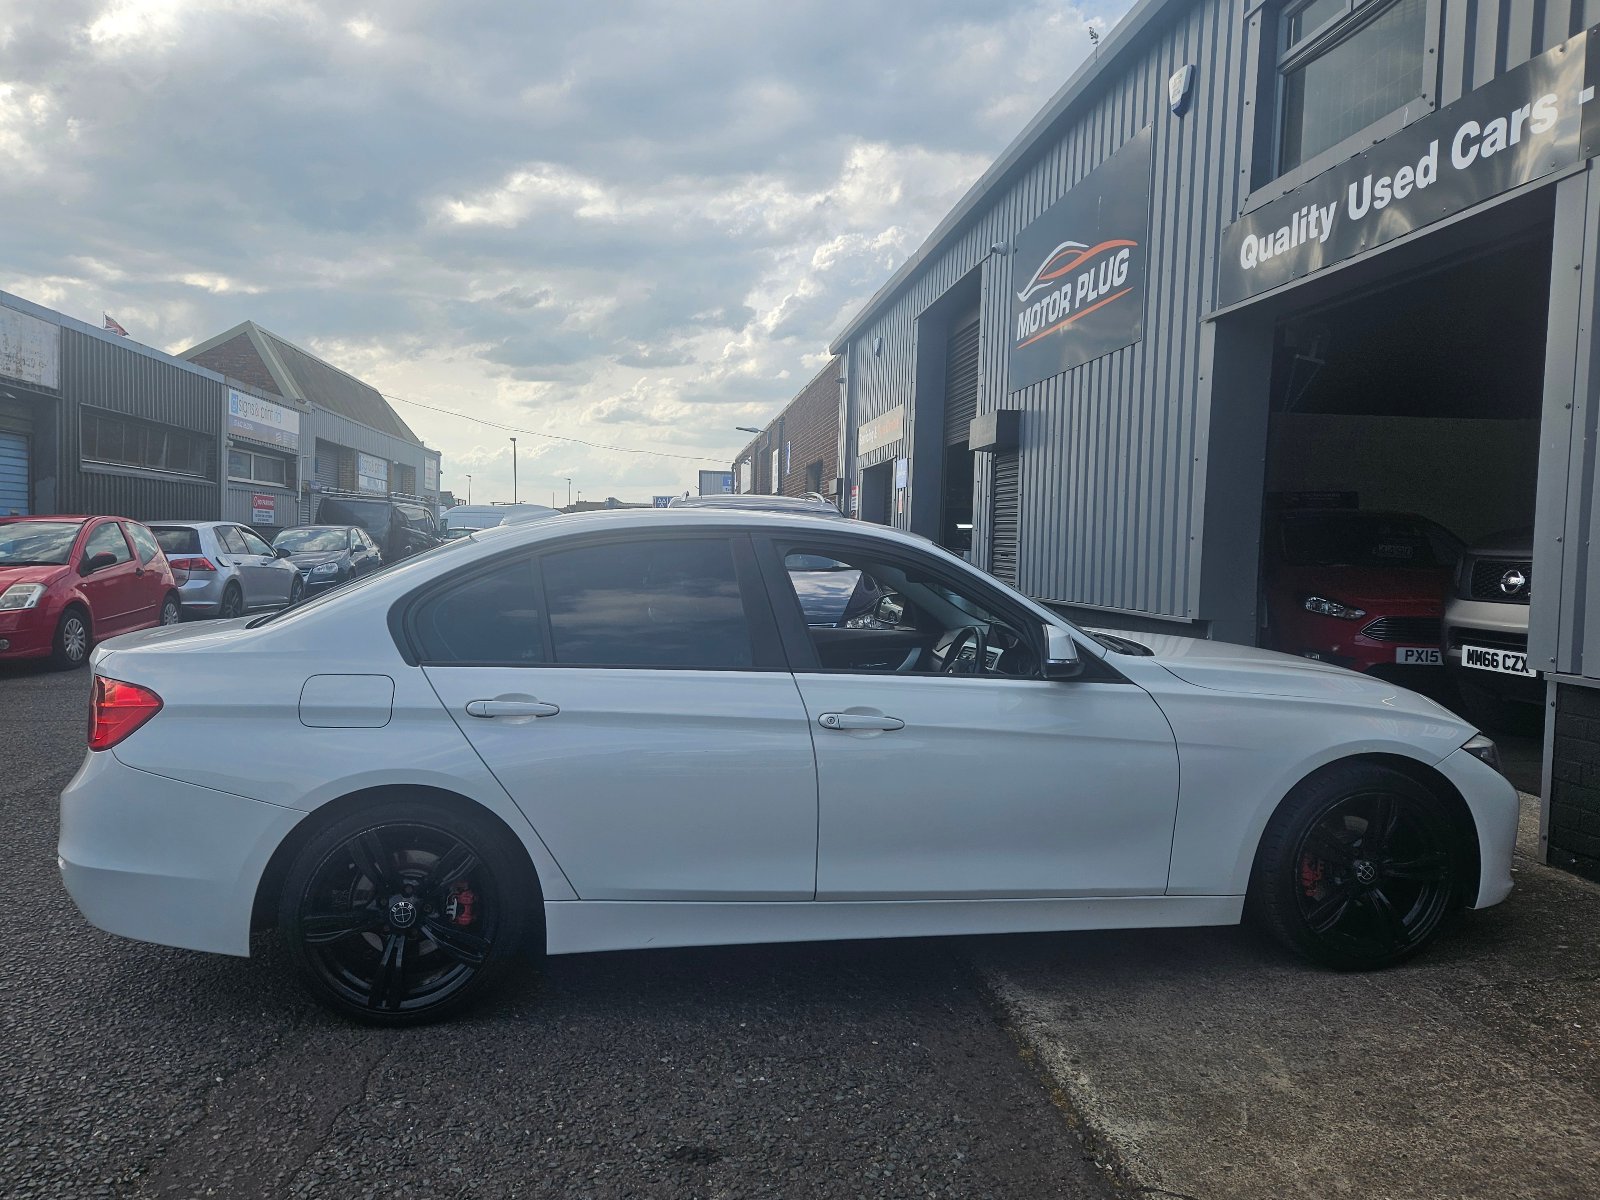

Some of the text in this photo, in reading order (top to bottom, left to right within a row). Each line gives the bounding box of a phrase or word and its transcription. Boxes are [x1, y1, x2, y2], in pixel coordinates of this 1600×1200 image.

[1240, 201, 1338, 270] Quality
[1348, 139, 1439, 221] Used
[1451, 93, 1559, 170] Cars
[1017, 247, 1130, 341] MOTOR PLUG
[1404, 649, 1439, 663] PX15
[1502, 653, 1530, 674] CZX
